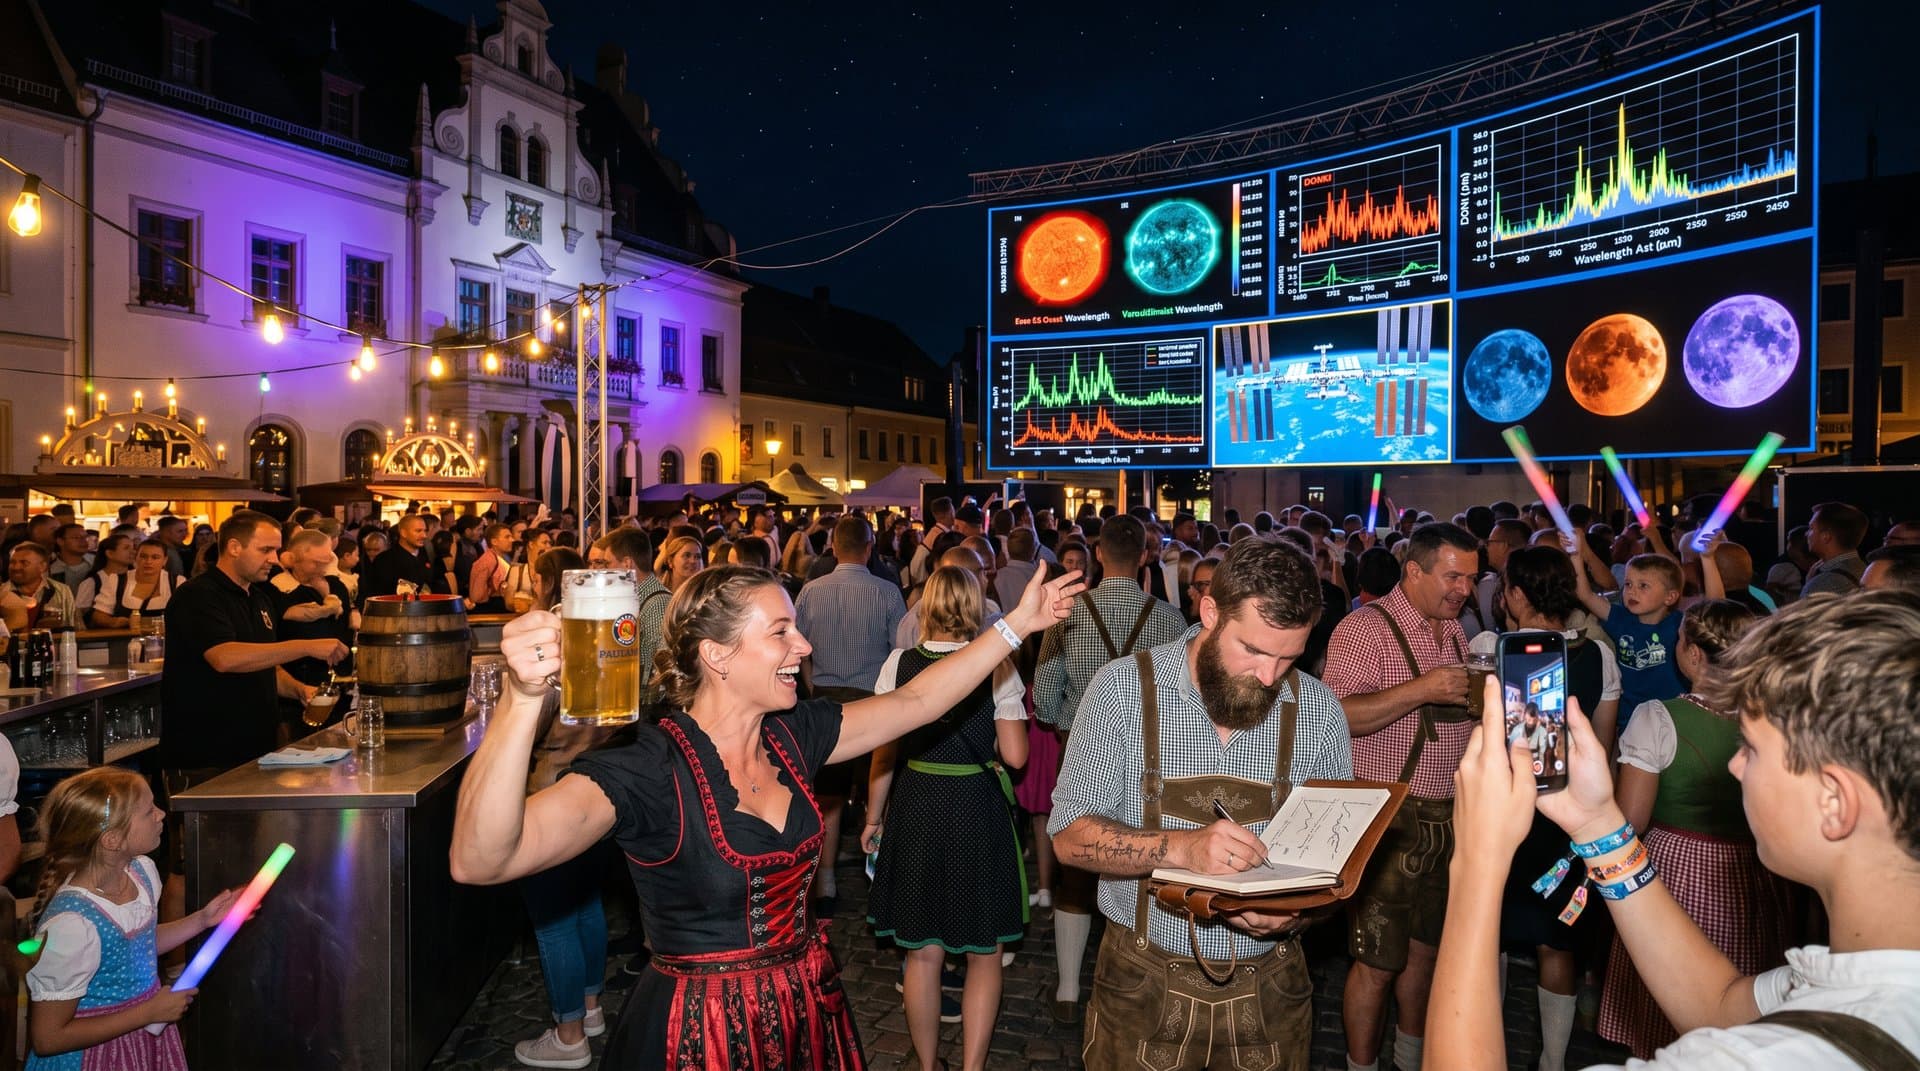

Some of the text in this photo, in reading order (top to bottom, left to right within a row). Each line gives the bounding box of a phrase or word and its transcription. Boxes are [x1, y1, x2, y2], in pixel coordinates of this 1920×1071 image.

[1580, 242, 1597, 251] 1250
[1549, 249, 1562, 257] 500
[1574, 246, 1633, 265] Wavelength
[1175, 302, 1223, 314] Wavelength
[1065, 312, 1110, 322] Wavelength
